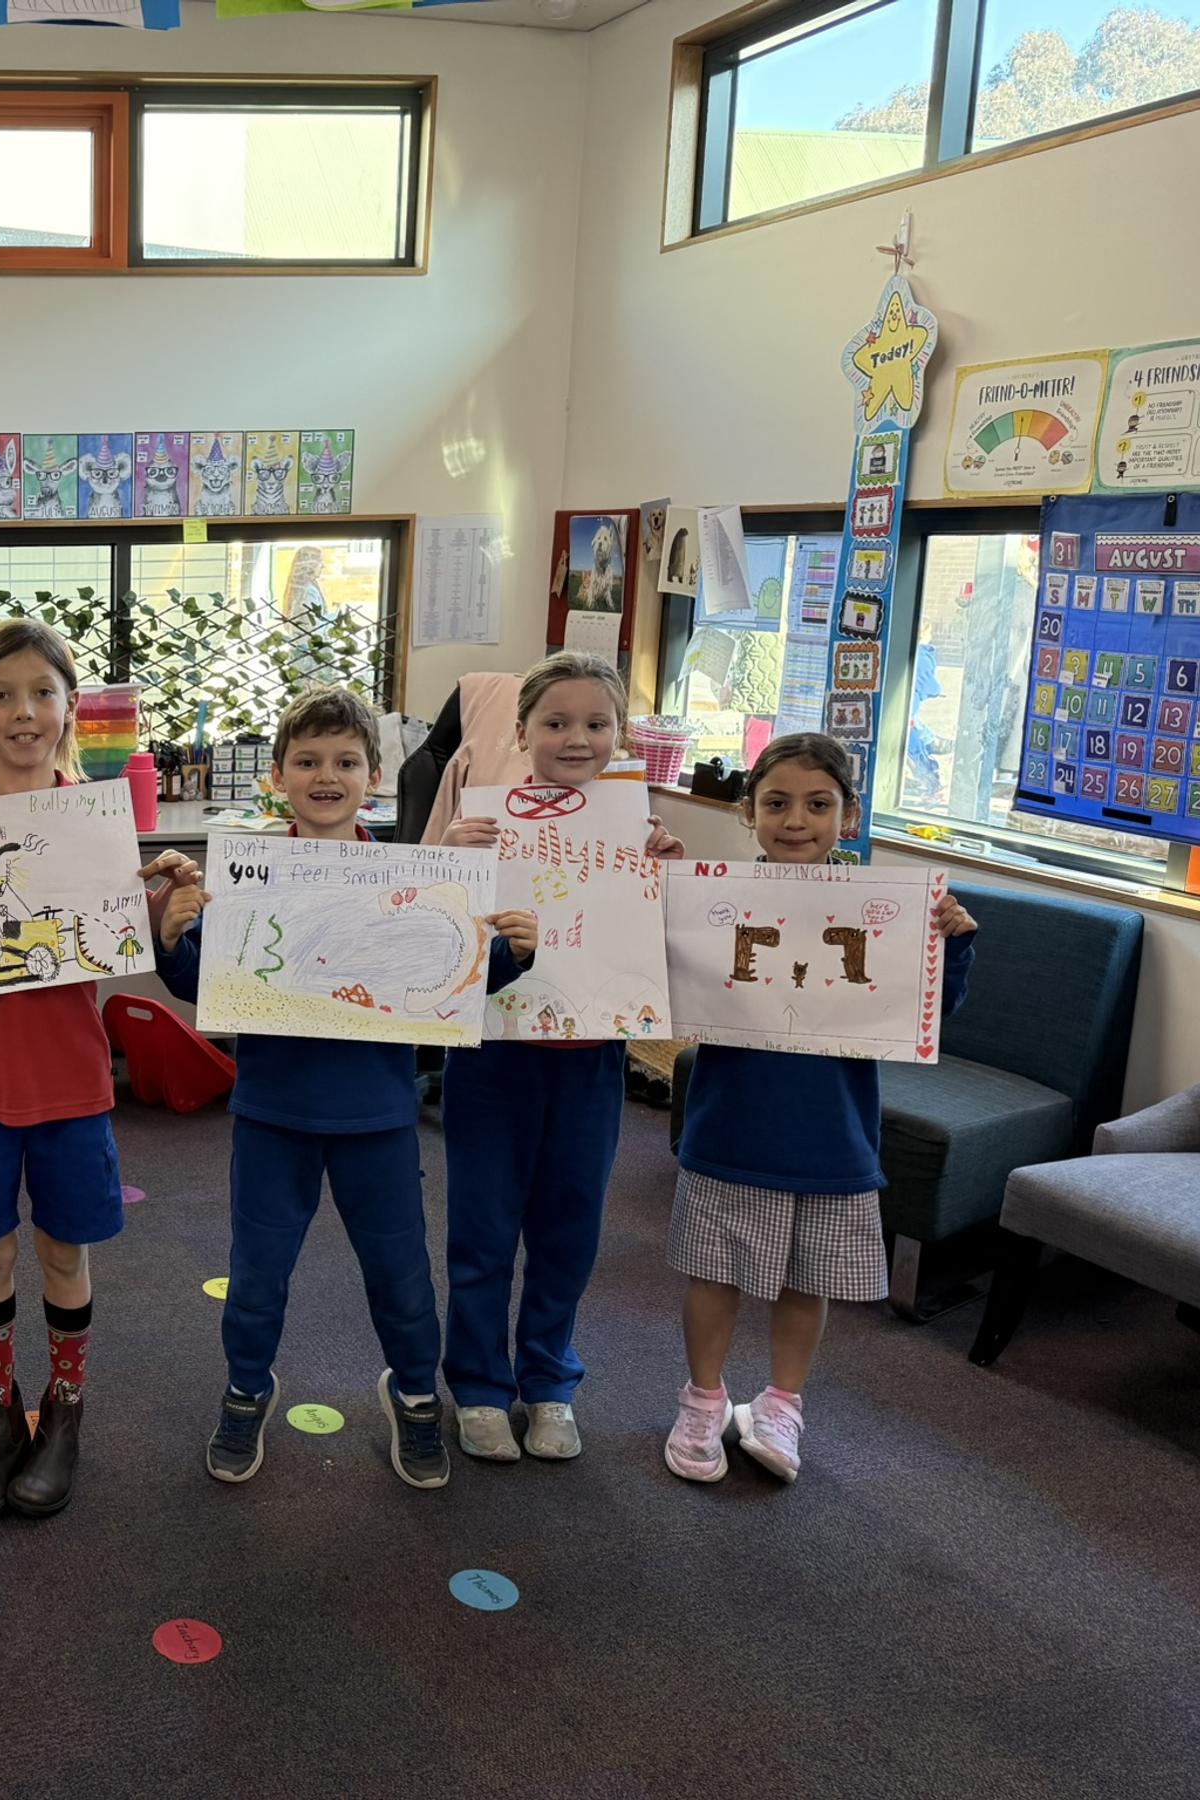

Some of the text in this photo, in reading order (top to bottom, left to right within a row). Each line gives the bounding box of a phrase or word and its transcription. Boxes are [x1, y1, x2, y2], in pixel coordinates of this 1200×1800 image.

[870, 339, 914, 368] Today!
[979, 376, 1075, 405] FRIEND-O-METER!
[1134, 370, 1144, 388] 4
[88, 504, 122, 517] AUGUST
[1055, 541, 1074, 562] 31
[1108, 548, 1186, 569] AUGUST
[1050, 589, 1059, 604] S
[1078, 591, 1089, 607] M
[1110, 593, 1119, 609] T
[1142, 596, 1157, 612] W
[1177, 599, 1197, 613] TH
[1041, 617, 1062, 637] 30
[1044, 655, 1052, 672] 2
[1071, 656, 1080, 675] 3
[1134, 662, 1145, 683] 5
[1176, 665, 1188, 687] 6
[1040, 690, 1183, 728] 9 10 11 12 13
[1032, 727, 1181, 766] 16 17 18 19 20
[1027, 762, 1046, 780] 23
[1056, 767, 1074, 786] 24
[1083, 773, 1105, 794] 25
[1117, 778, 1140, 799] 26
[1150, 784, 1175, 806] 27
[223, 839, 270, 859] Don't
[290, 839, 320, 855] Let
[339, 842, 388, 859] Bullies
[498, 820, 662, 901] Bullying
[229, 861, 329, 885] you feel
[695, 862, 728, 878] NO
[304, 1408, 329, 1429] Angus
[467, 1573, 503, 1604] Thomas
[176, 1622, 201, 1659] Zachary
